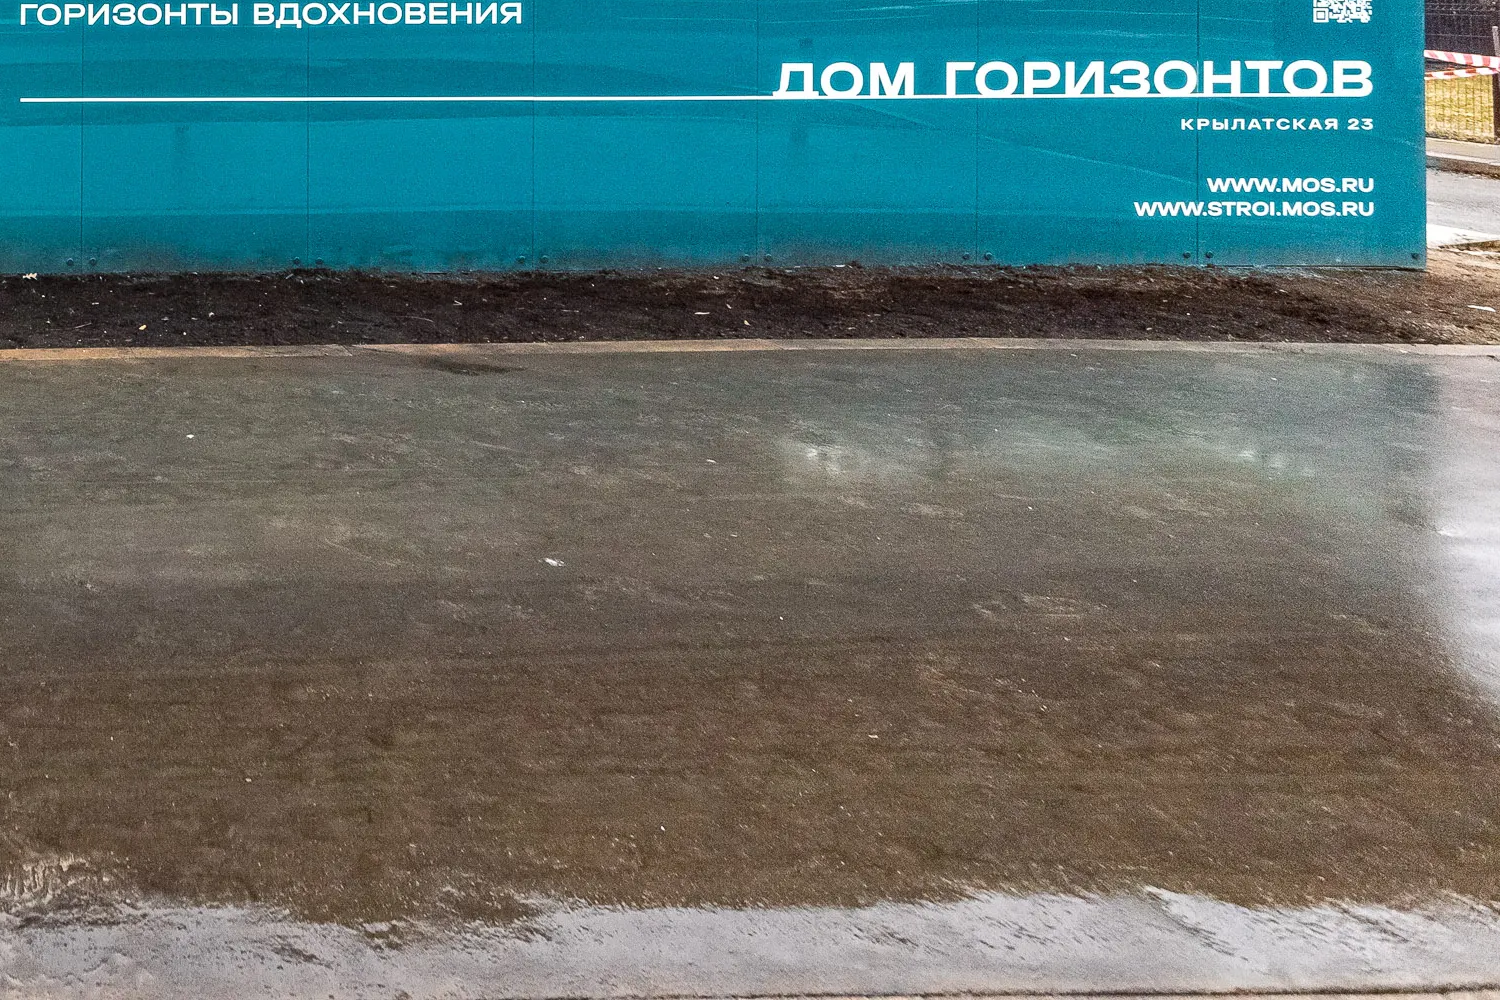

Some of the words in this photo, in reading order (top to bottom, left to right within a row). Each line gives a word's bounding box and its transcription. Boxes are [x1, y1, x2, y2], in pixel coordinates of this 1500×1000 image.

[19, 2, 239, 27] ГОРИЗОНТЫ
[253, 1, 523, 29] ВДОХНОВЕНИЯ
[772, 61, 916, 98] ДОМ
[945, 59, 1374, 98] ГОРИЗОНТОВ
[1180, 117, 1339, 132] КРЫЛАТСКАЯ
[1346, 117, 1374, 131] 23
[1206, 177, 1375, 194] WWW.MOS.RU
[1133, 201, 1375, 218] WWW.STROI.MOS.RU
